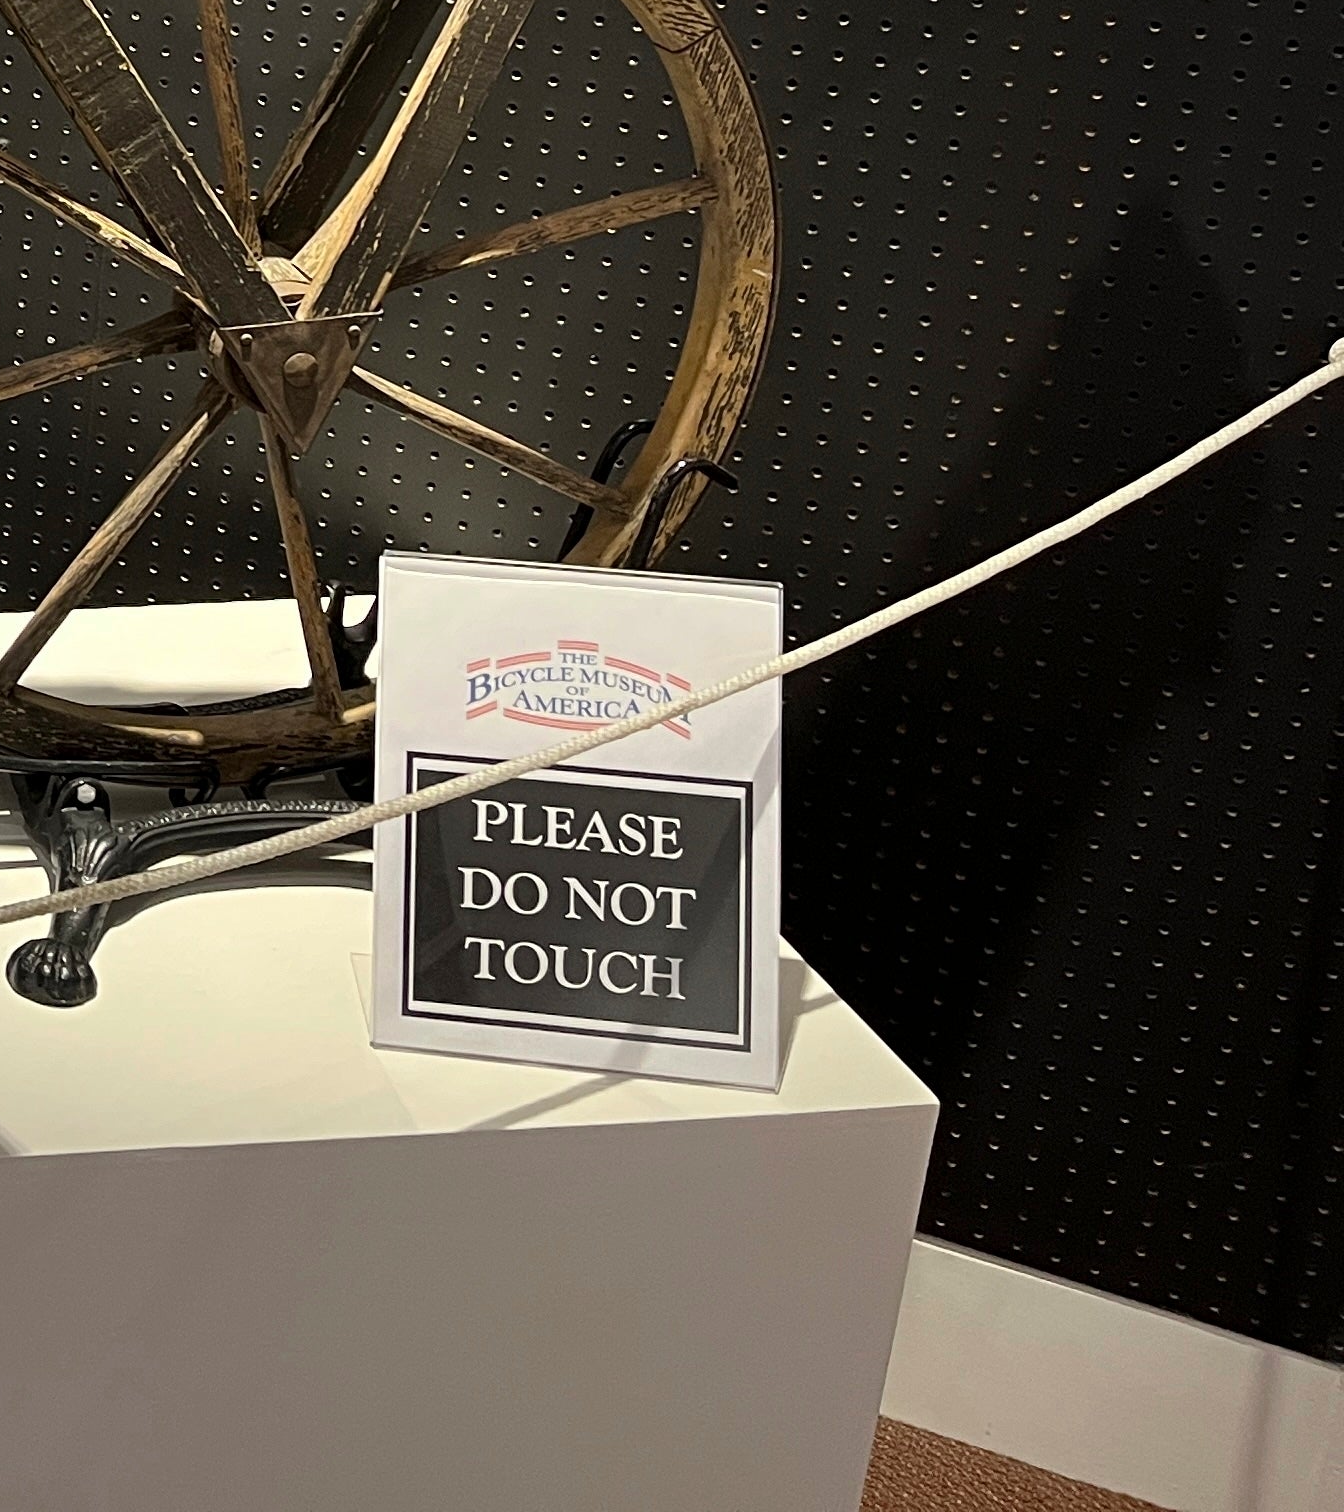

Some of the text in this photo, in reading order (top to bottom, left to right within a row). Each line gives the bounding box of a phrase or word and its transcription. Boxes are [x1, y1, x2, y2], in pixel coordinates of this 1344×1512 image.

[558, 652, 597, 666] THE
[467, 667, 574, 706] BICYCLE
[513, 690, 641, 719] AMERICA
[566, 686, 589, 696] OF
[472, 798, 683, 860] PLEASE
[458, 866, 696, 930] DO NOT
[464, 936, 686, 1000] TOUCH
